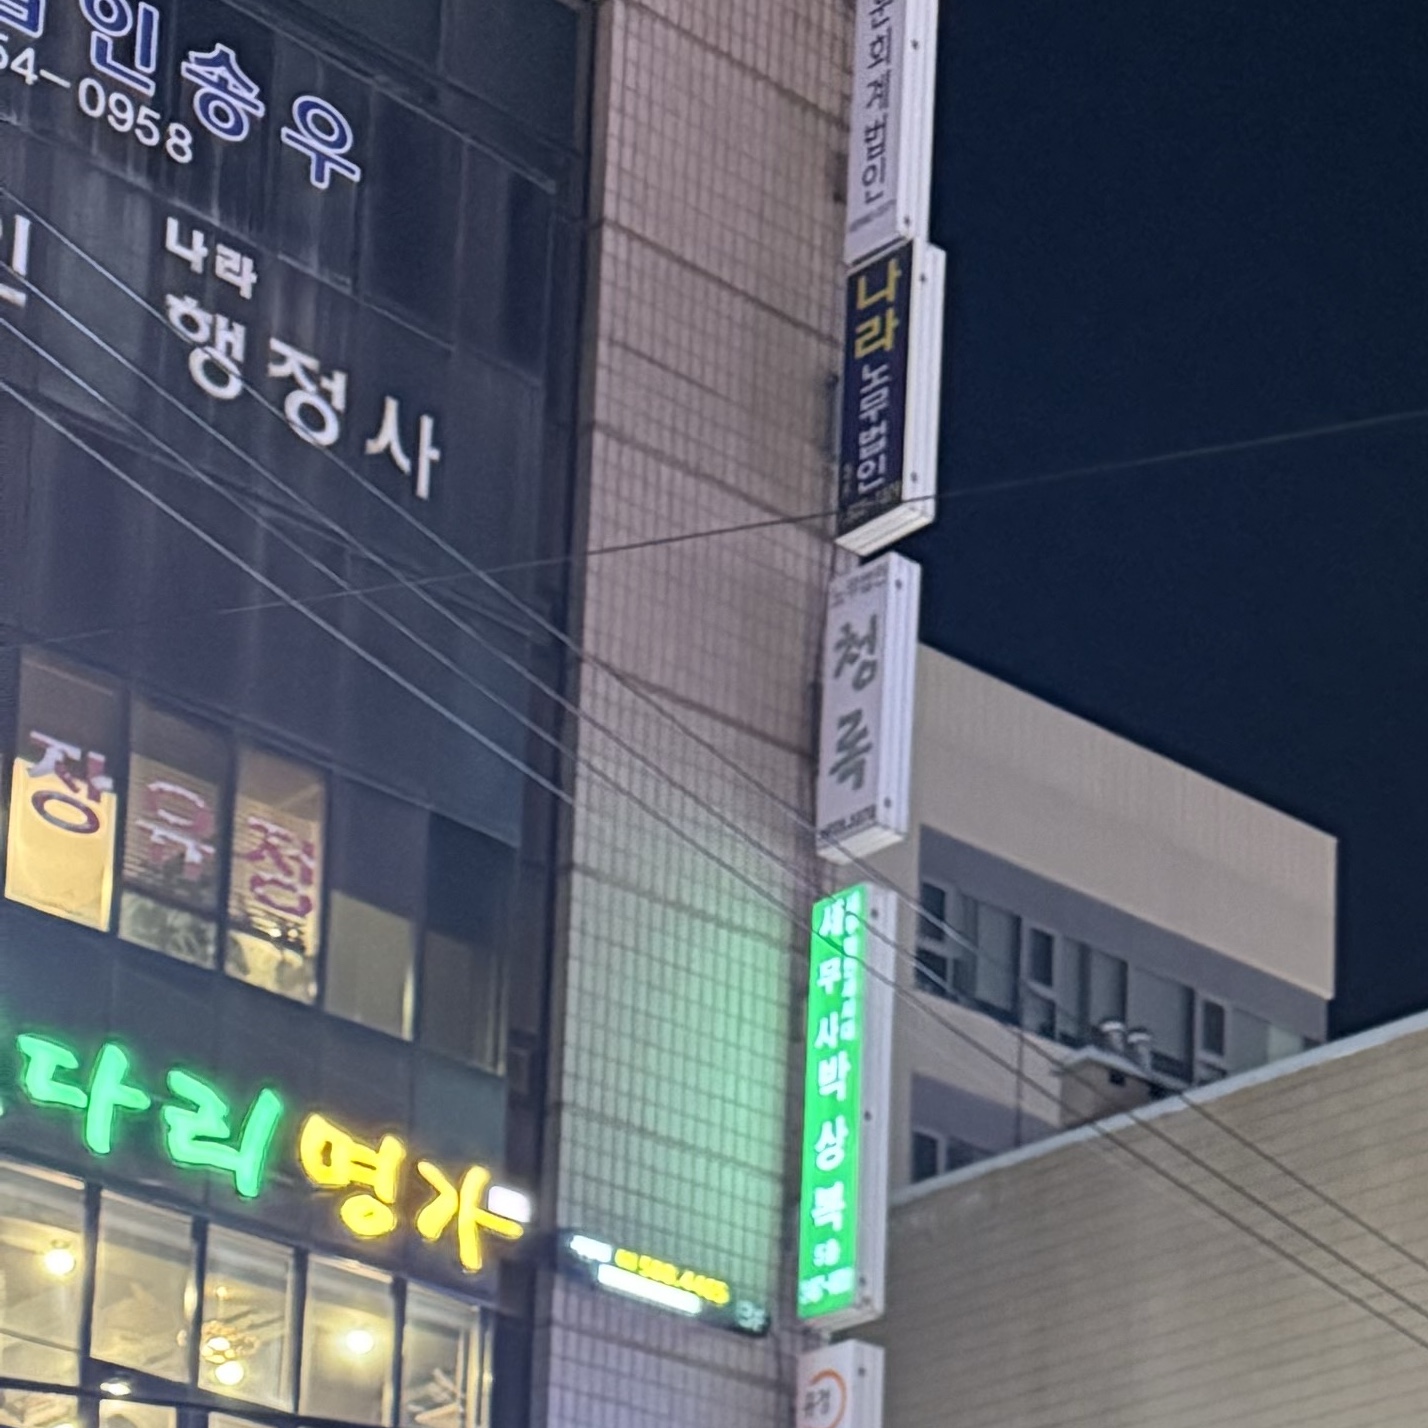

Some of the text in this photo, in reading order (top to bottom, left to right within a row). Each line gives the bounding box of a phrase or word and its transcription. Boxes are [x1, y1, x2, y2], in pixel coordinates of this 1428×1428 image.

[166, 217, 258, 300] 나라
[855, 257, 900, 360] 나라
[163, 293, 441, 499] 행정사
[0, 1031, 524, 1272] 다리 명가
